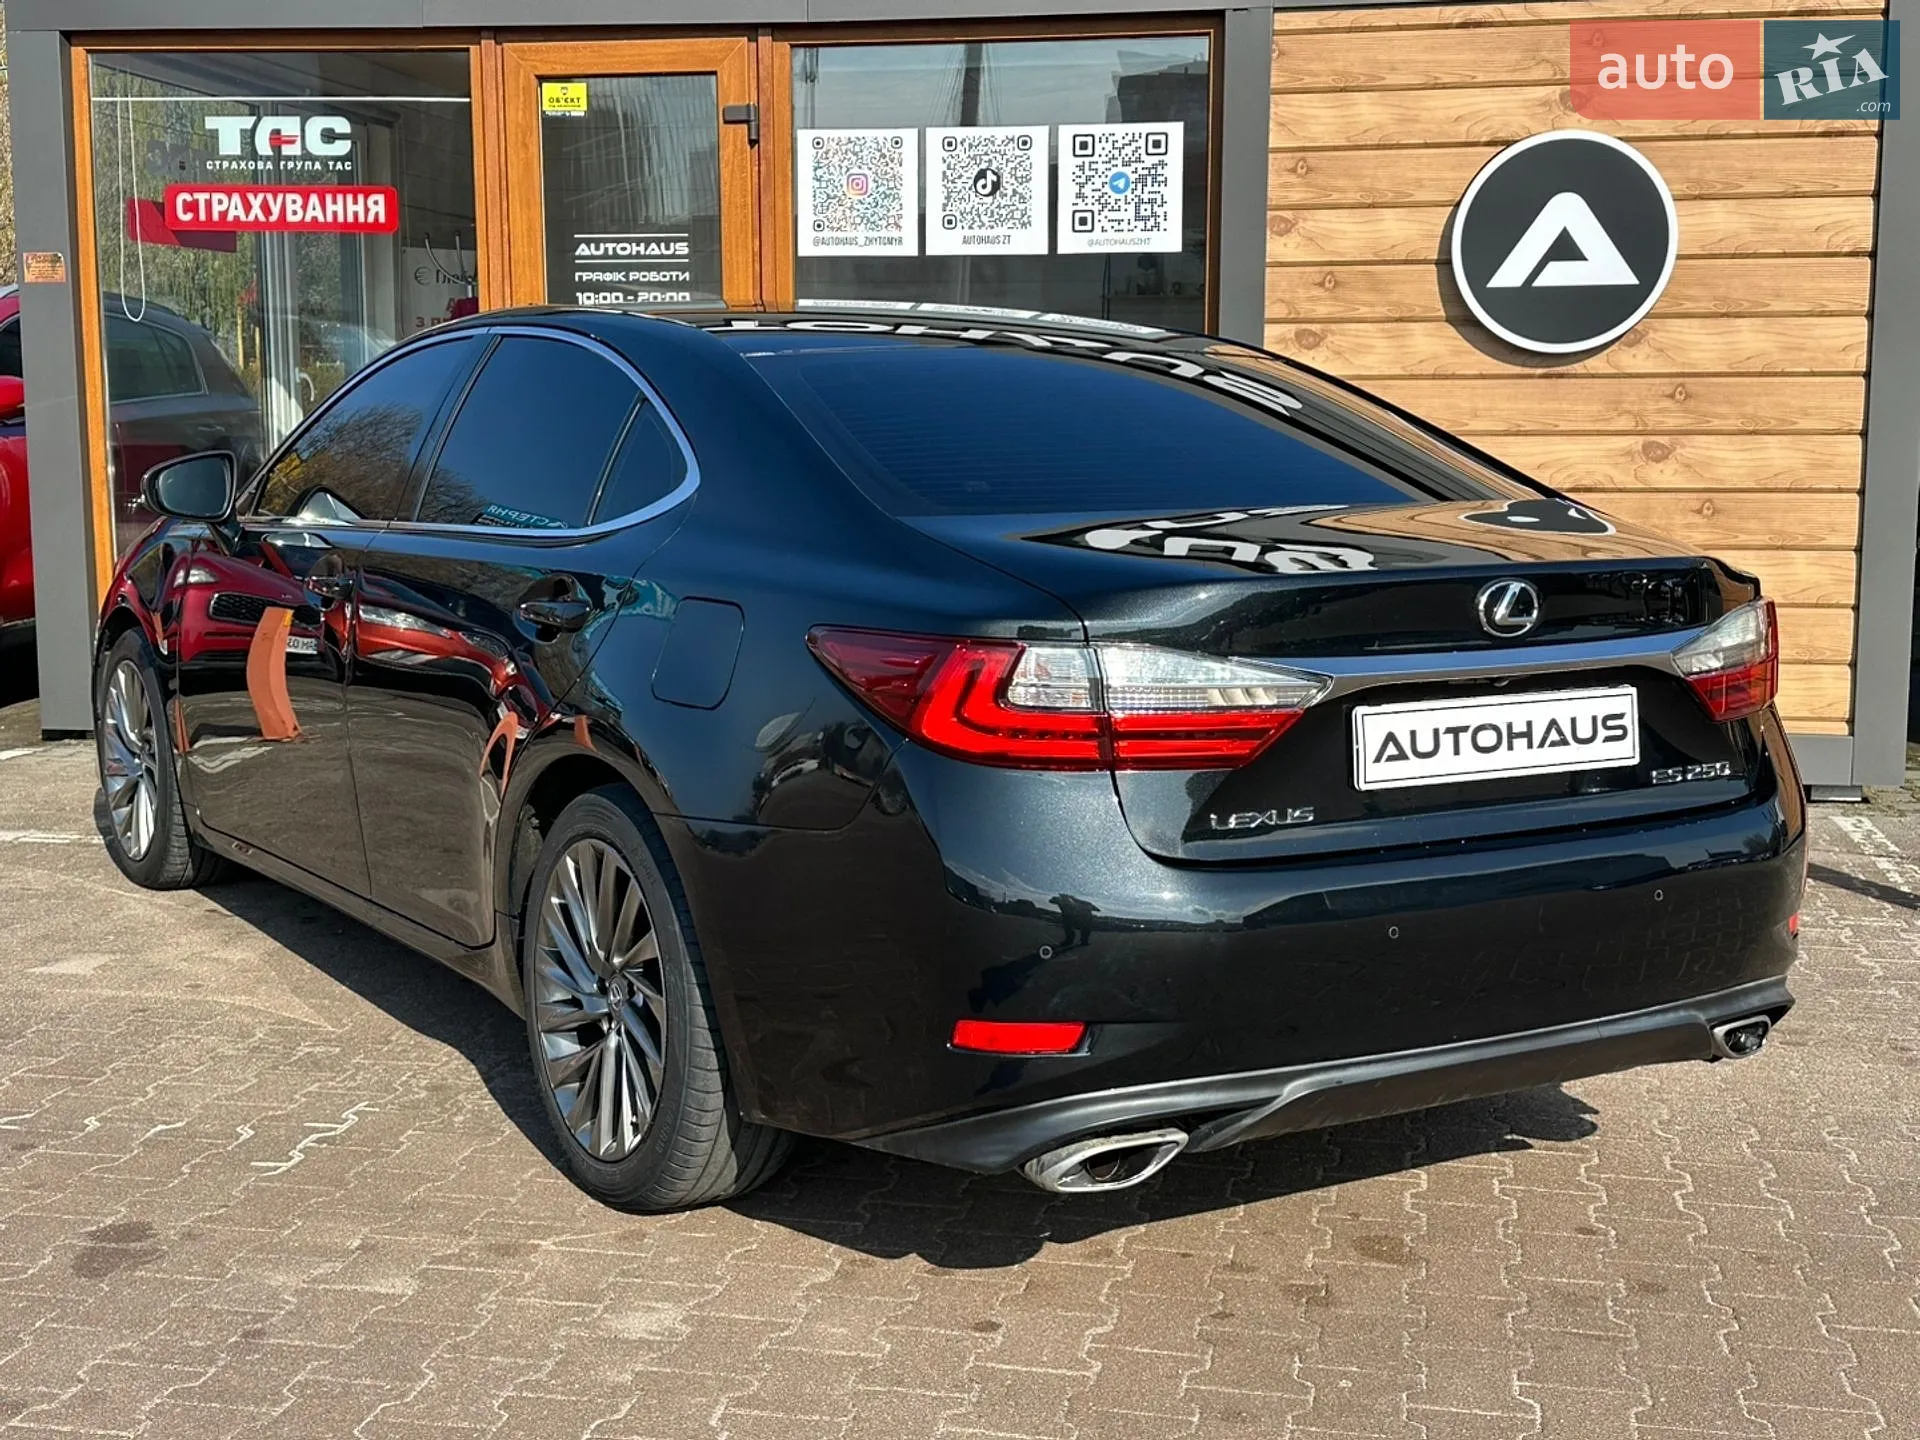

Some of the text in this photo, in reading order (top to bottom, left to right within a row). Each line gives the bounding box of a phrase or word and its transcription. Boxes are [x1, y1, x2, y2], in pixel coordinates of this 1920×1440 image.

[206, 160, 352, 171] СТРАХОВА ГРУПА ТАС
[174, 191, 386, 224] СТРАХУВАННЯ
[574, 242, 689, 256] AUTOHAUS
[574, 271, 690, 282] ГРАФІК РОБОТИ
[576, 292, 623, 305] 10:00
[1372, 712, 1628, 764] AUTOHAUS
[1652, 761, 1731, 784] ES 250
[1210, 807, 1315, 830] LEXUS
